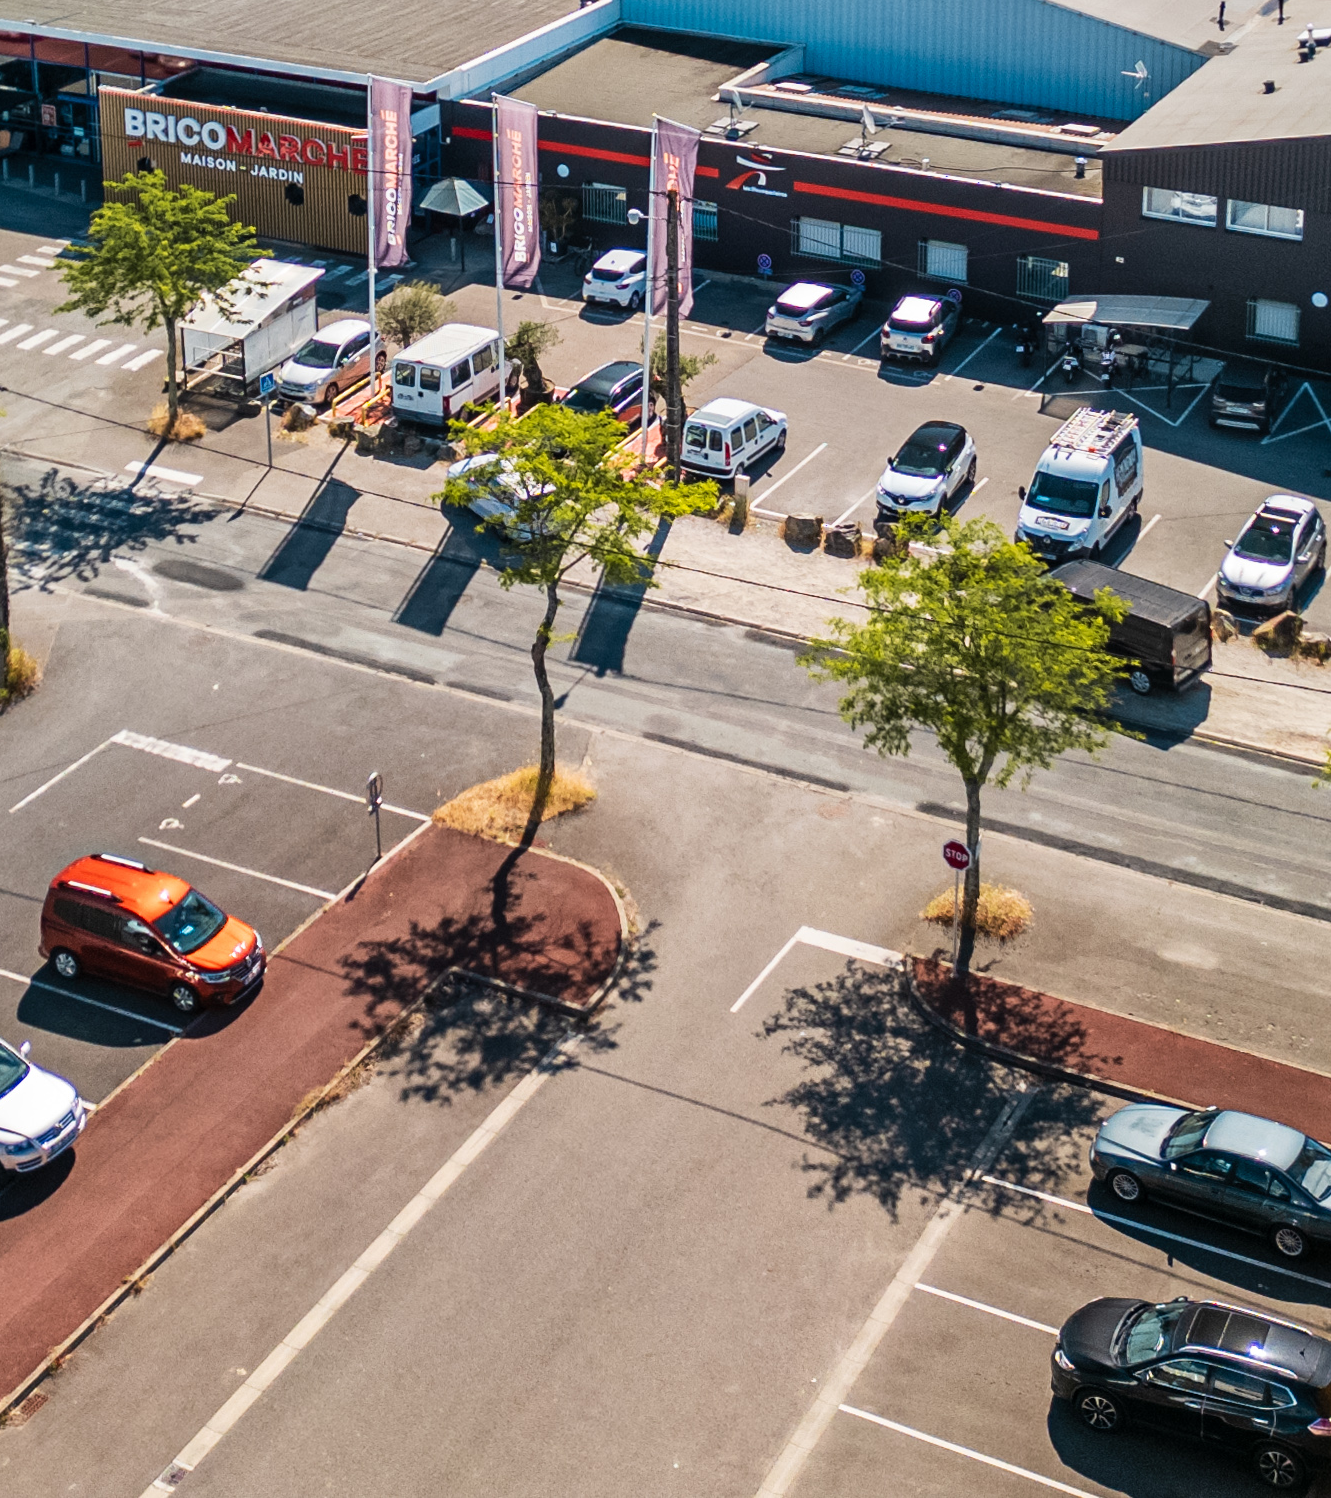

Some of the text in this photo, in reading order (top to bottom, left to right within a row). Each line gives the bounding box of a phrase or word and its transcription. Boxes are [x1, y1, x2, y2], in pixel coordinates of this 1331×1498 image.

[180, 152, 236, 173] MAISON
[250, 164, 304, 184] JARDIN
[506, 128, 527, 263] BRICOMARCHÉ
[945, 848, 968, 863] STOP
